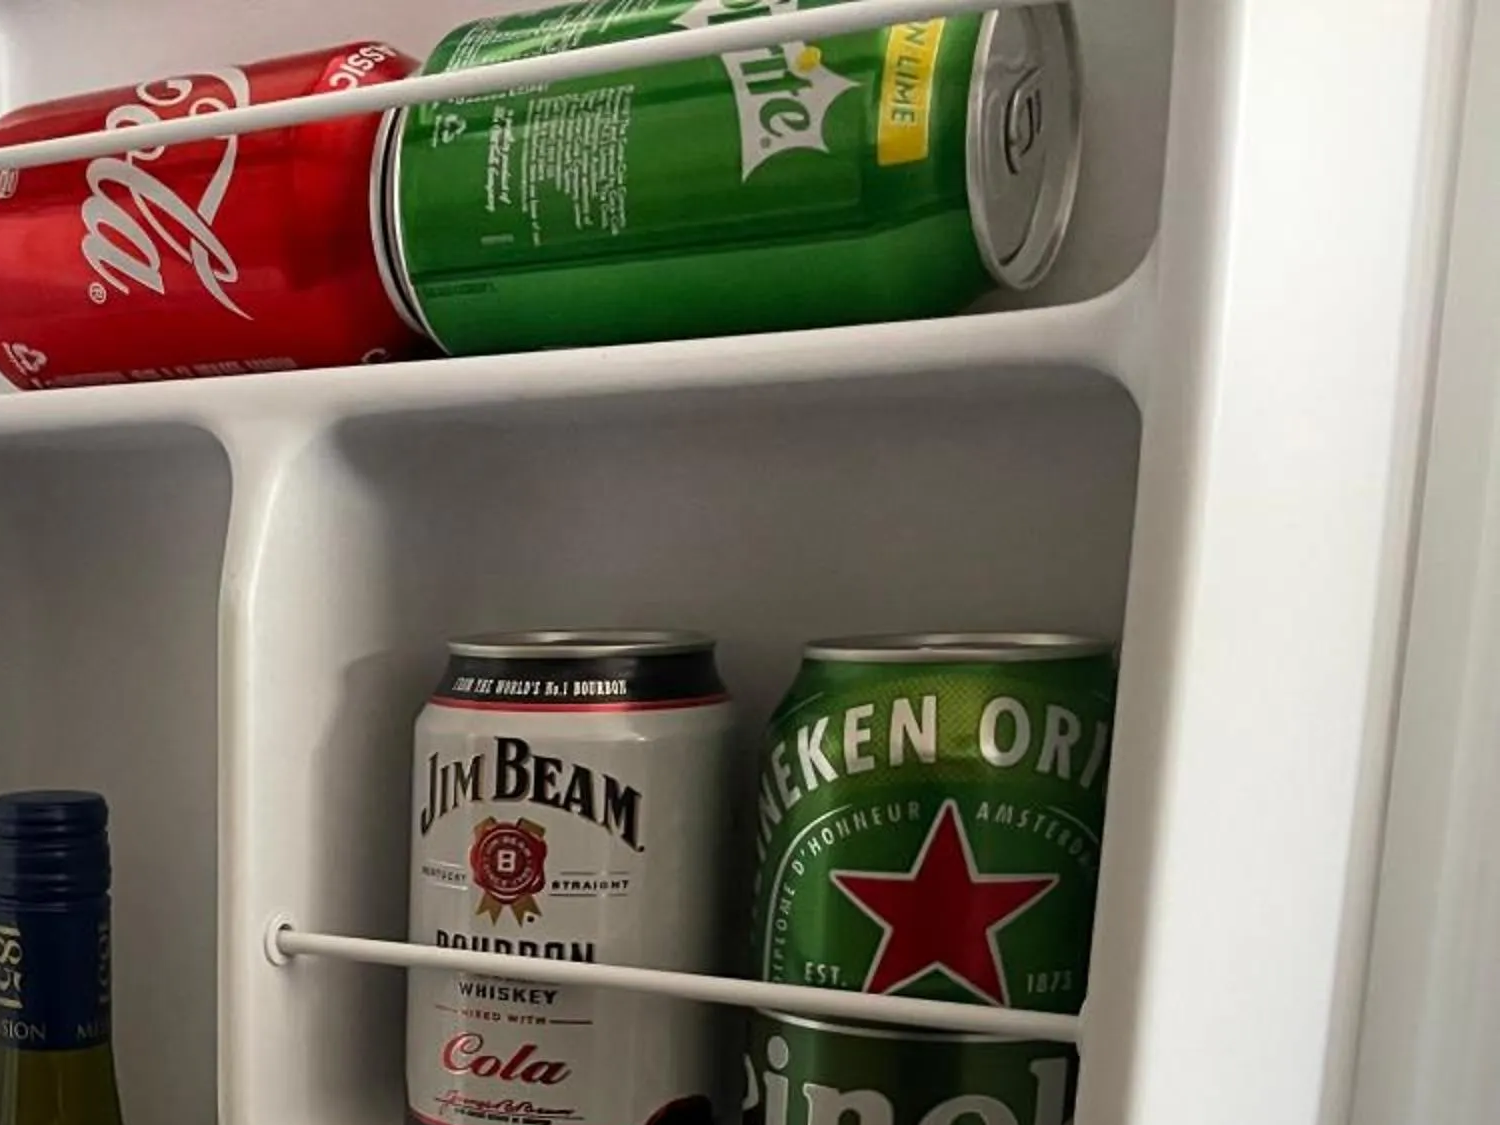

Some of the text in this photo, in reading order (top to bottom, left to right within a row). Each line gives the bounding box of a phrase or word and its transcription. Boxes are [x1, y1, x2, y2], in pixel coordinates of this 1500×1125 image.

[890, 55, 921, 125] LIME
[495, 680, 541, 696] WORLD'S
[573, 680, 628, 696] BOURBON
[419, 751, 483, 837] JIM
[791, 801, 921, 876] D'HONNEUR
[551, 878, 630, 891] STRAIGHT
[458, 981, 558, 1005] WHISKEY
[803, 961, 848, 987] EST.
[442, 1031, 573, 1086] Cola
